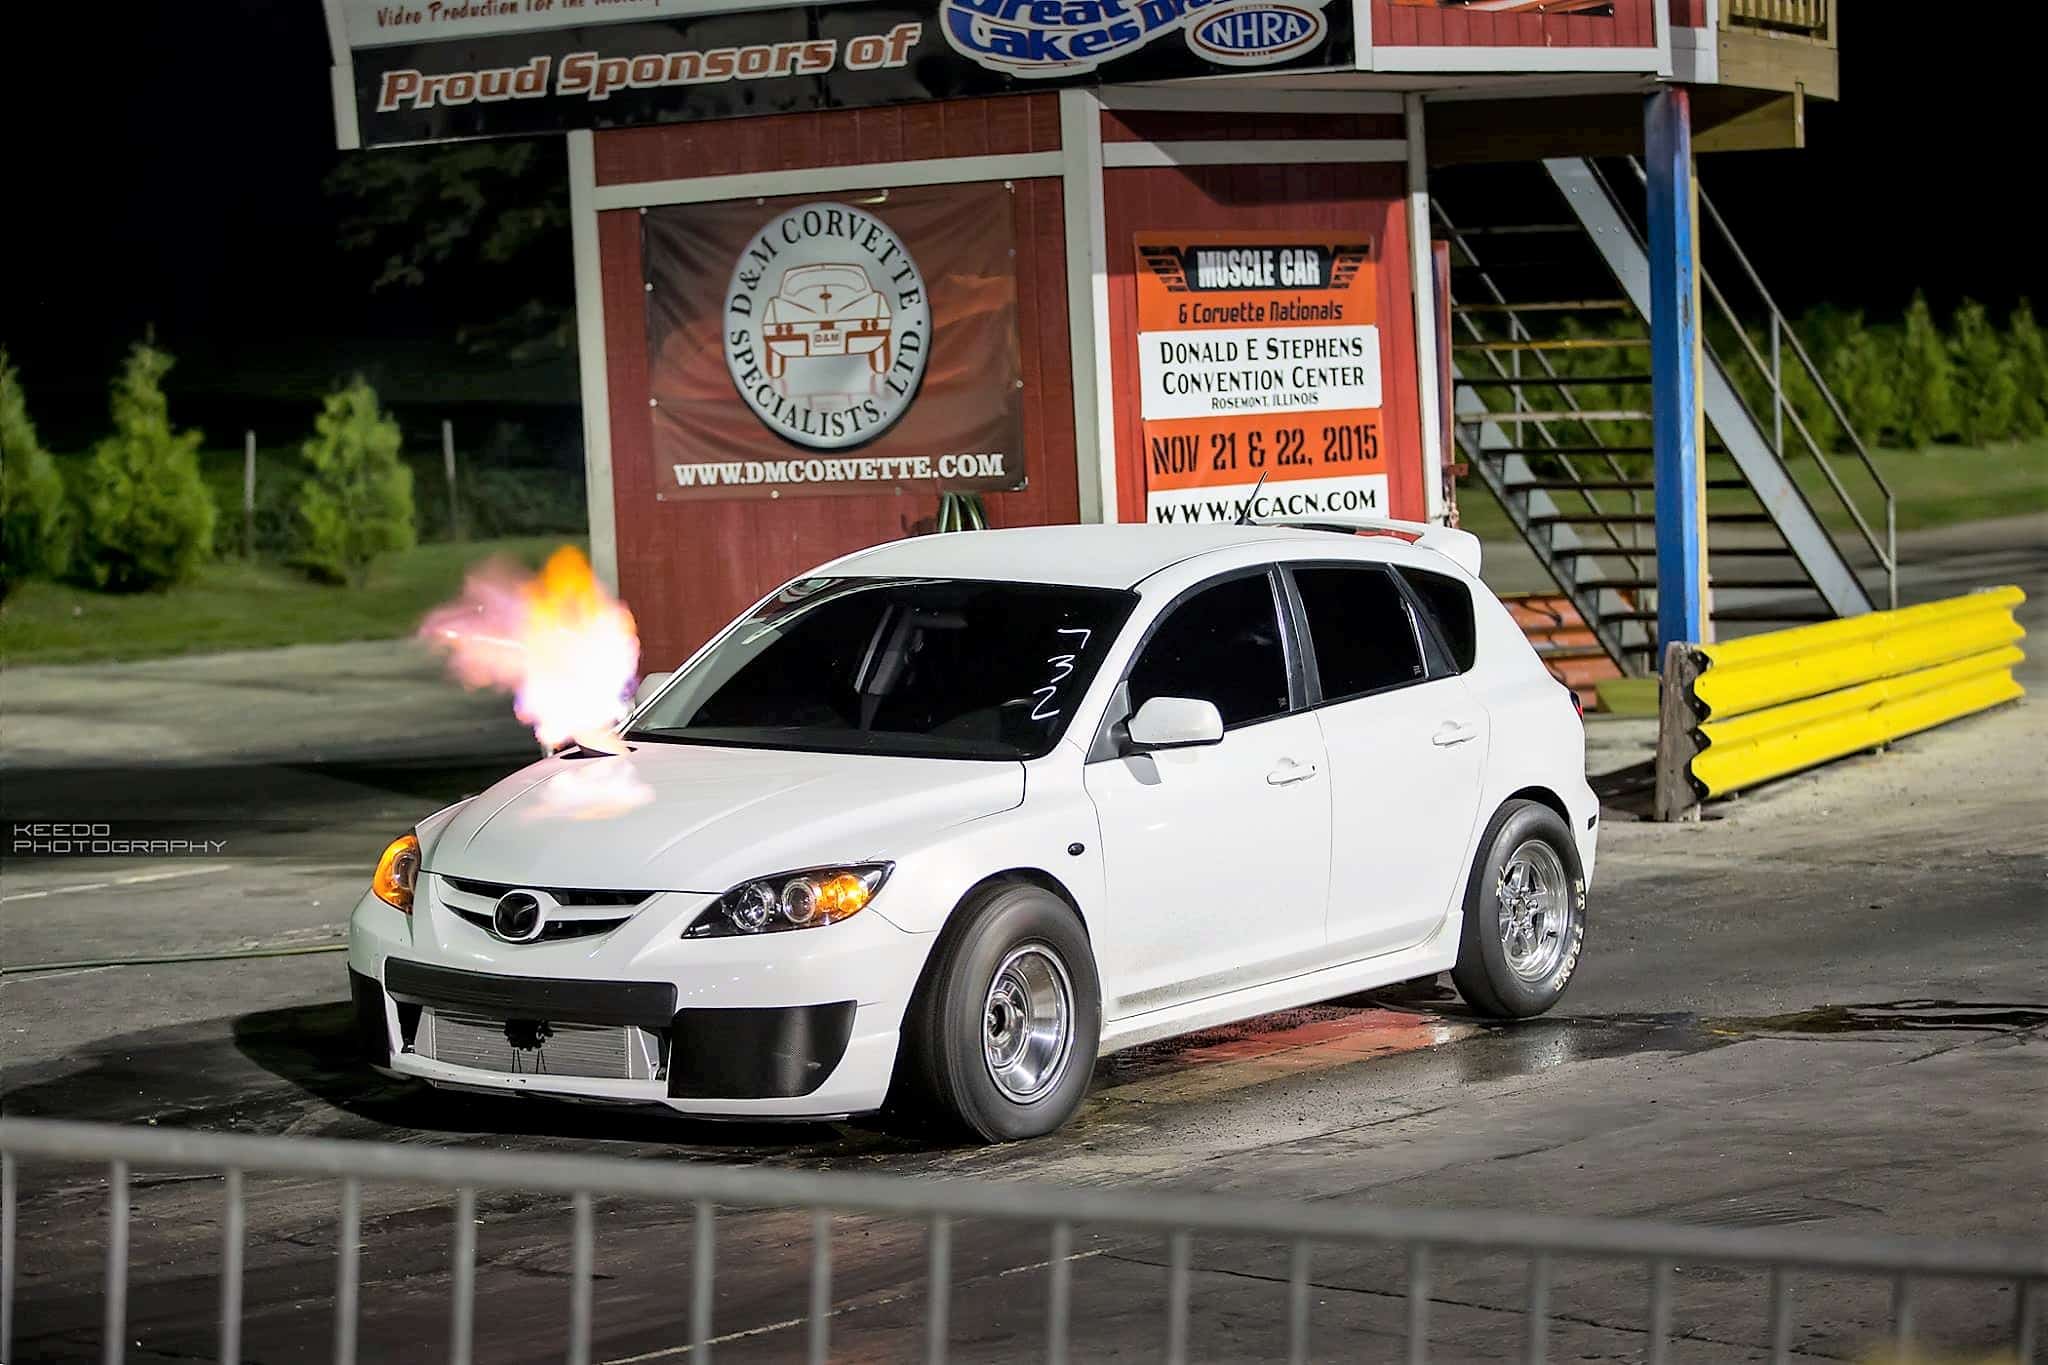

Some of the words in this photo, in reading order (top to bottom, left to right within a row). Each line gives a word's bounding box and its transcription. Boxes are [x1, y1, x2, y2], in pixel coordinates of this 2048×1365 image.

[377, 6, 422, 27] Video
[427, 0, 518, 22] Production
[1212, 12, 1301, 47] NHRA
[947, 8, 1142, 61] Lakes
[376, 57, 552, 112] Proud
[556, 37, 836, 100] Sponsors
[844, 22, 923, 71] of
[730, 237, 779, 318] D&M
[781, 209, 922, 310] CORVETTE
[1197, 250, 1275, 289] MUSCLE
[1279, 249, 1321, 287] CAR
[1192, 301, 1265, 323] Corvette
[1269, 297, 1344, 321] Nationals
[1160, 340, 1238, 365] DONALD
[1247, 338, 1259, 361] E
[1266, 337, 1363, 360] STEPHENS
[1162, 369, 1284, 395] CONVENTION
[1292, 366, 1364, 389] CENTER
[1272, 391, 1319, 408] ILLINOIS
[1152, 434, 1200, 475] NOV
[1211, 432, 1237, 470] 21
[1248, 431, 1266, 467] &
[1275, 428, 1313, 466] 22,
[1323, 424, 1378, 463] 2015
[673, 453, 1005, 487] WWW.DMCORVETTE.COM
[1155, 489, 1377, 524] WWW.MCACN.COM
